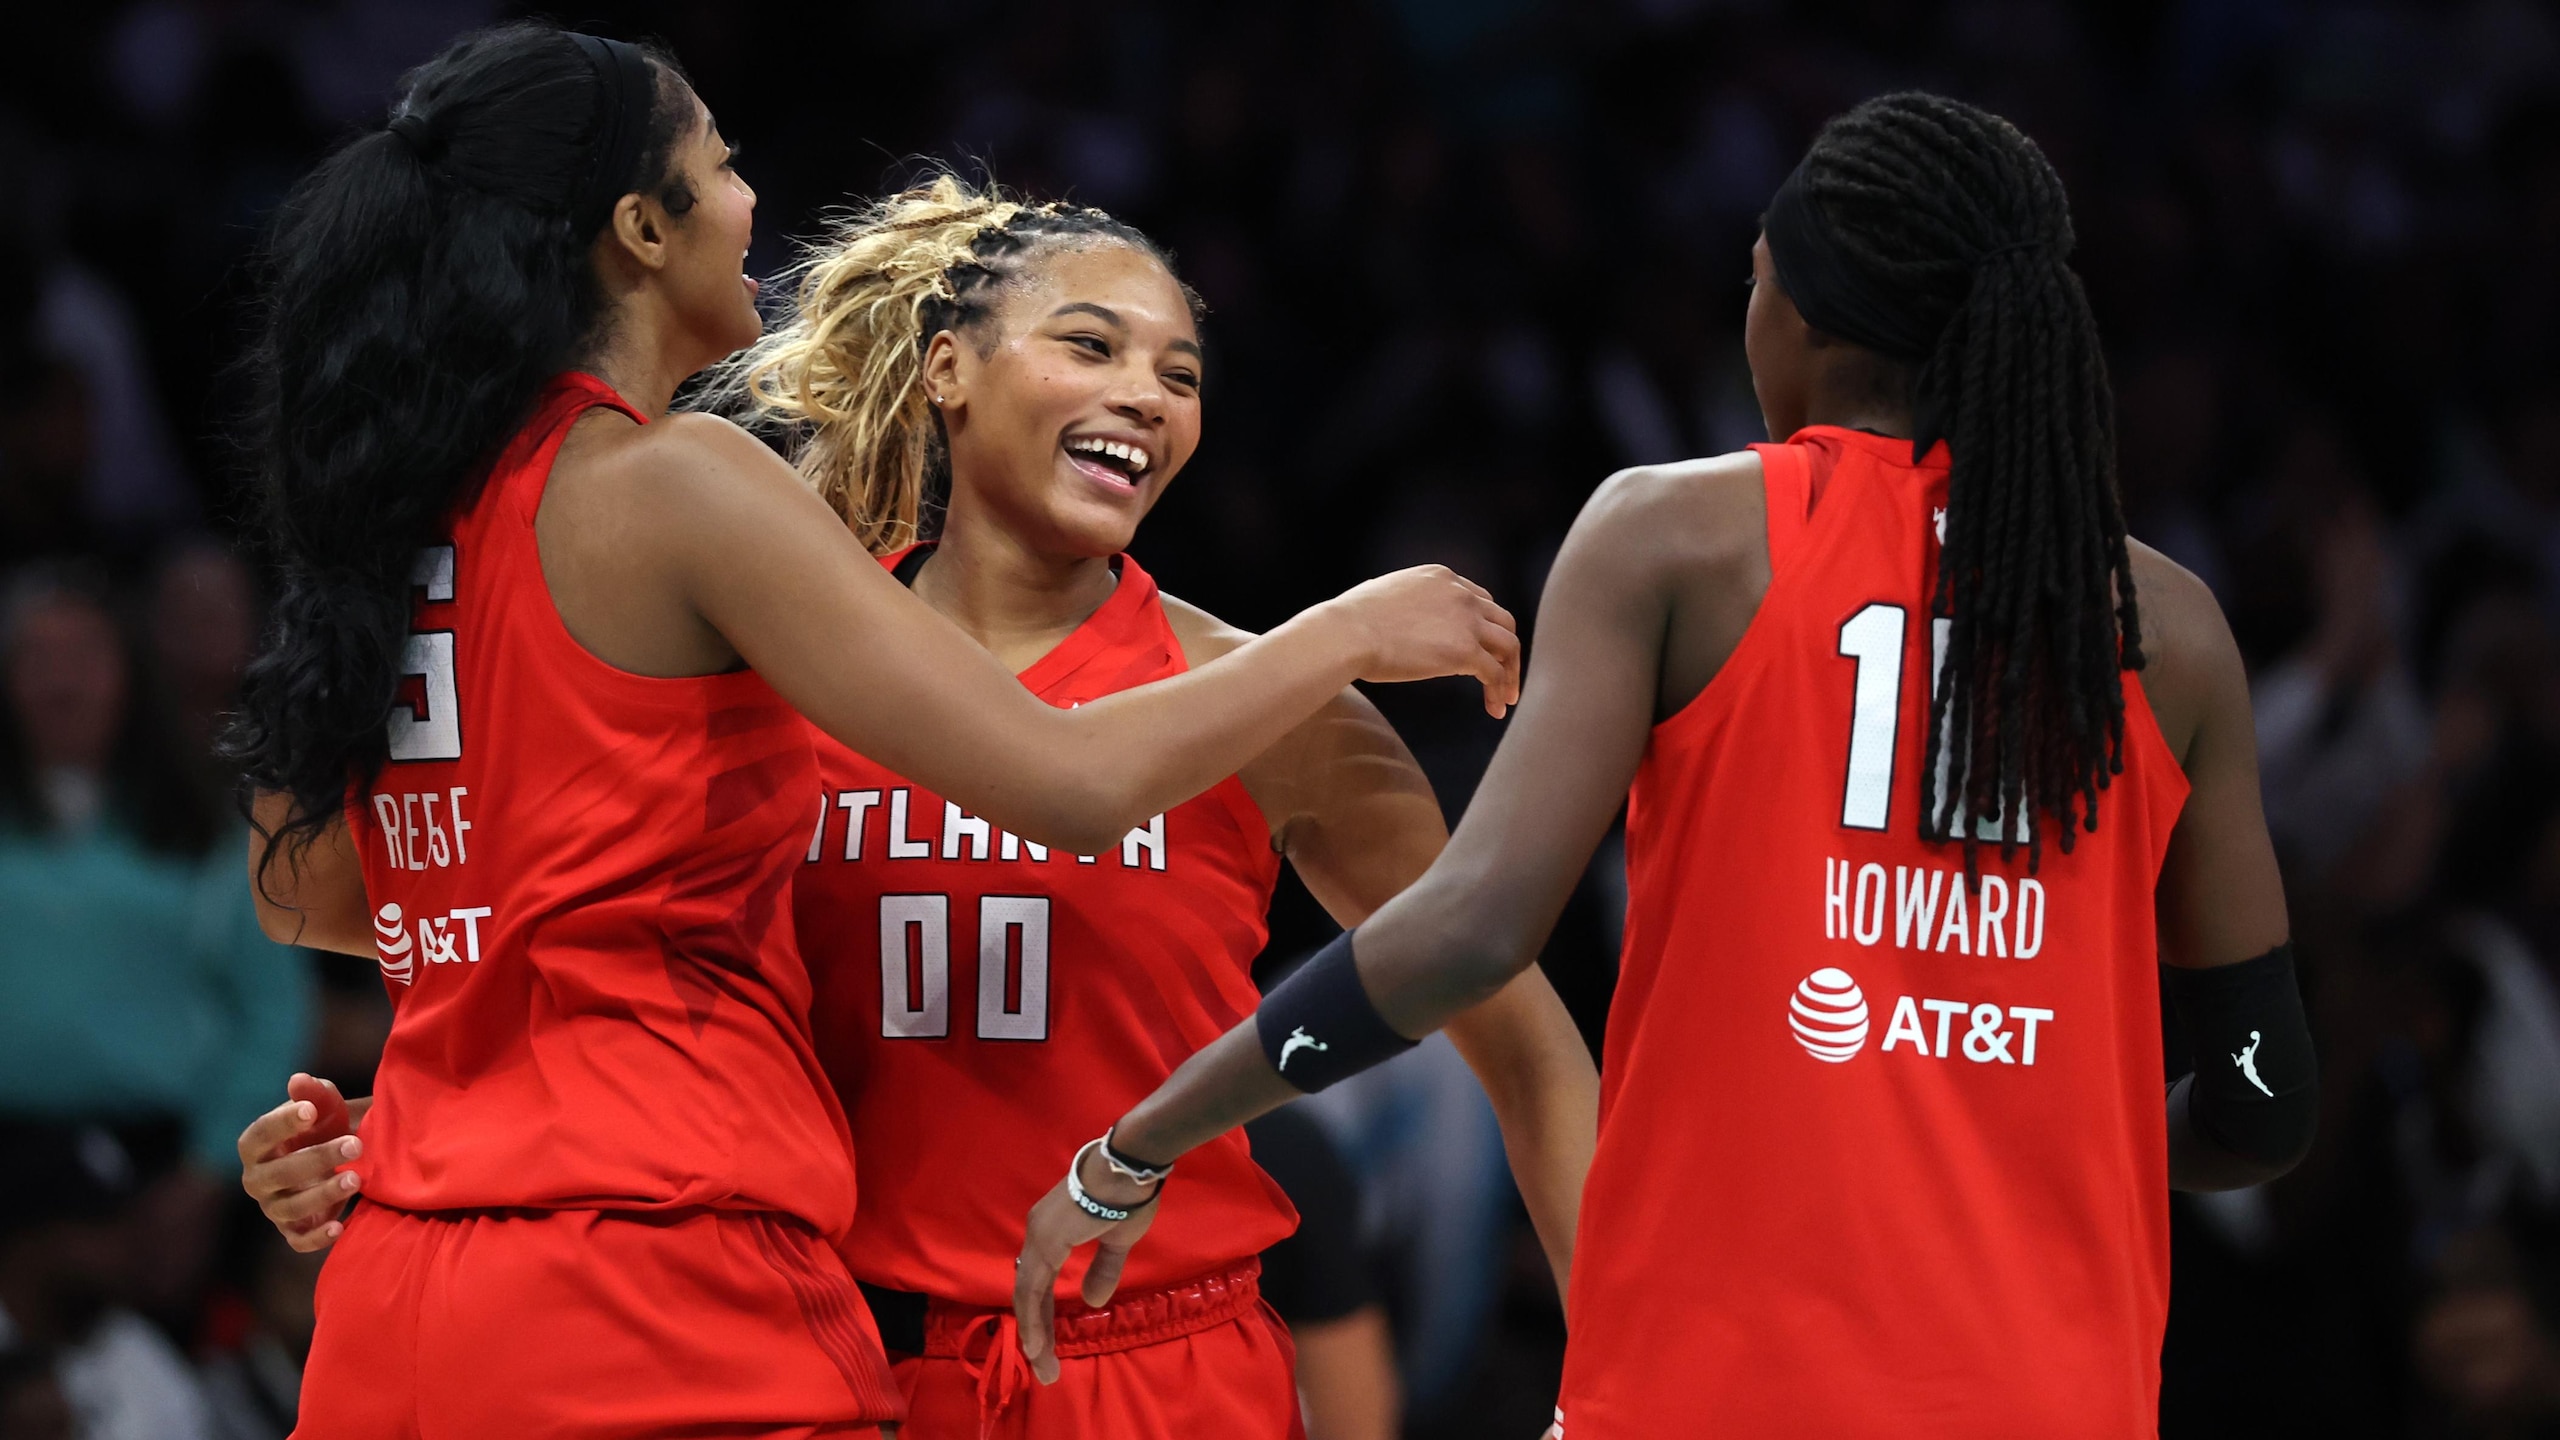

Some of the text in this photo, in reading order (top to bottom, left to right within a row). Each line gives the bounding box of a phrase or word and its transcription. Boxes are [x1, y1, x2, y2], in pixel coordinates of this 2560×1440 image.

[388, 544, 462, 762] 5
[1836, 602, 2032, 843] 1
[806, 784, 1167, 872] TLAA
[878, 892, 1051, 1042] 00
[1825, 856, 2046, 961] HOWARD
[1881, 994, 2055, 1067] AT&T
